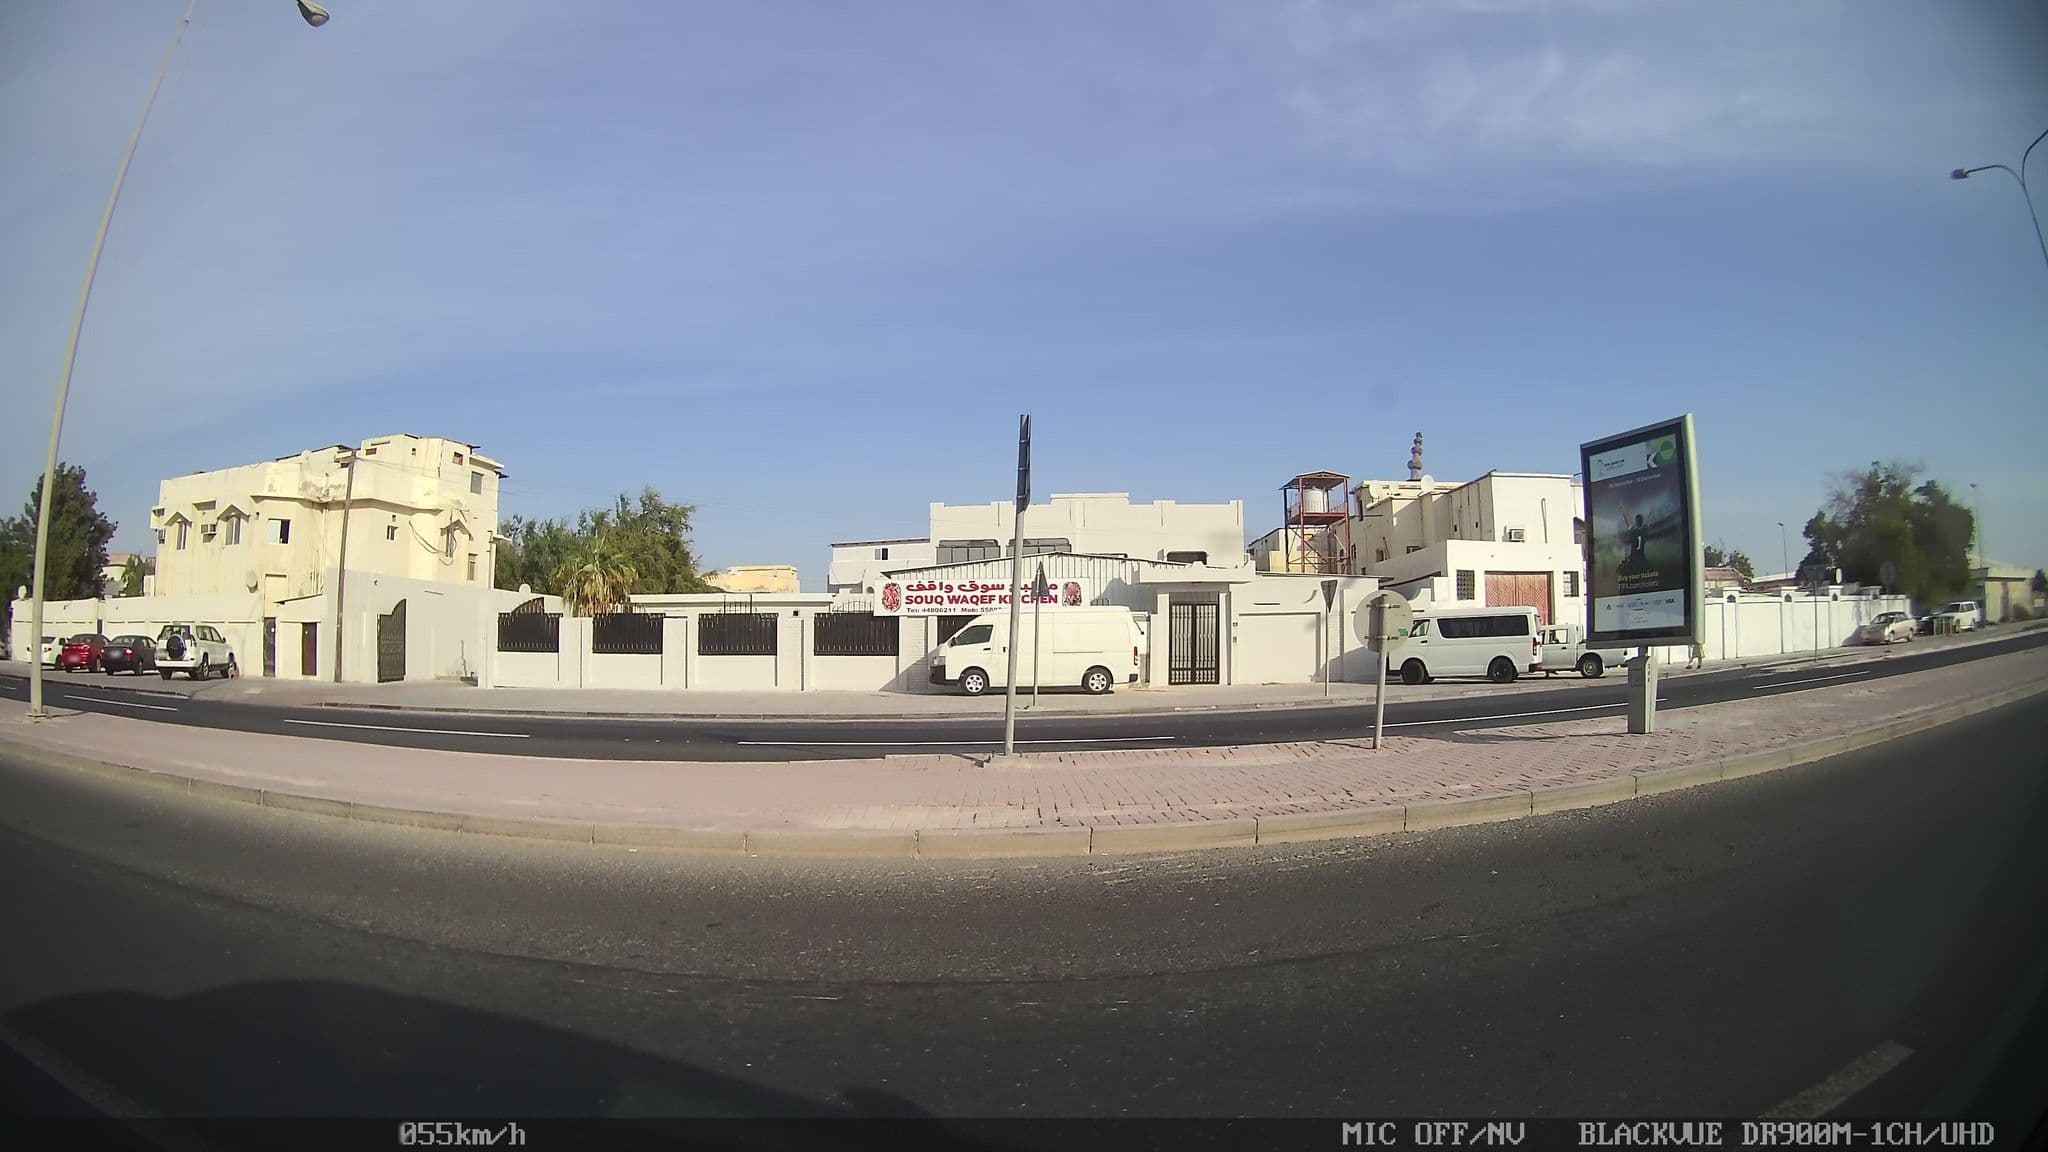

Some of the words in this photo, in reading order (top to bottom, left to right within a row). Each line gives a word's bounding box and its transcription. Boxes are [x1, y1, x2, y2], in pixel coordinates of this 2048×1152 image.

[906, 580, 954, 593] واقف
[957, 580, 1005, 593] سوق
[905, 595, 944, 606] SOUQ
[947, 595, 996, 606] WAQEF
[999, 594, 1058, 604] KICHEN
